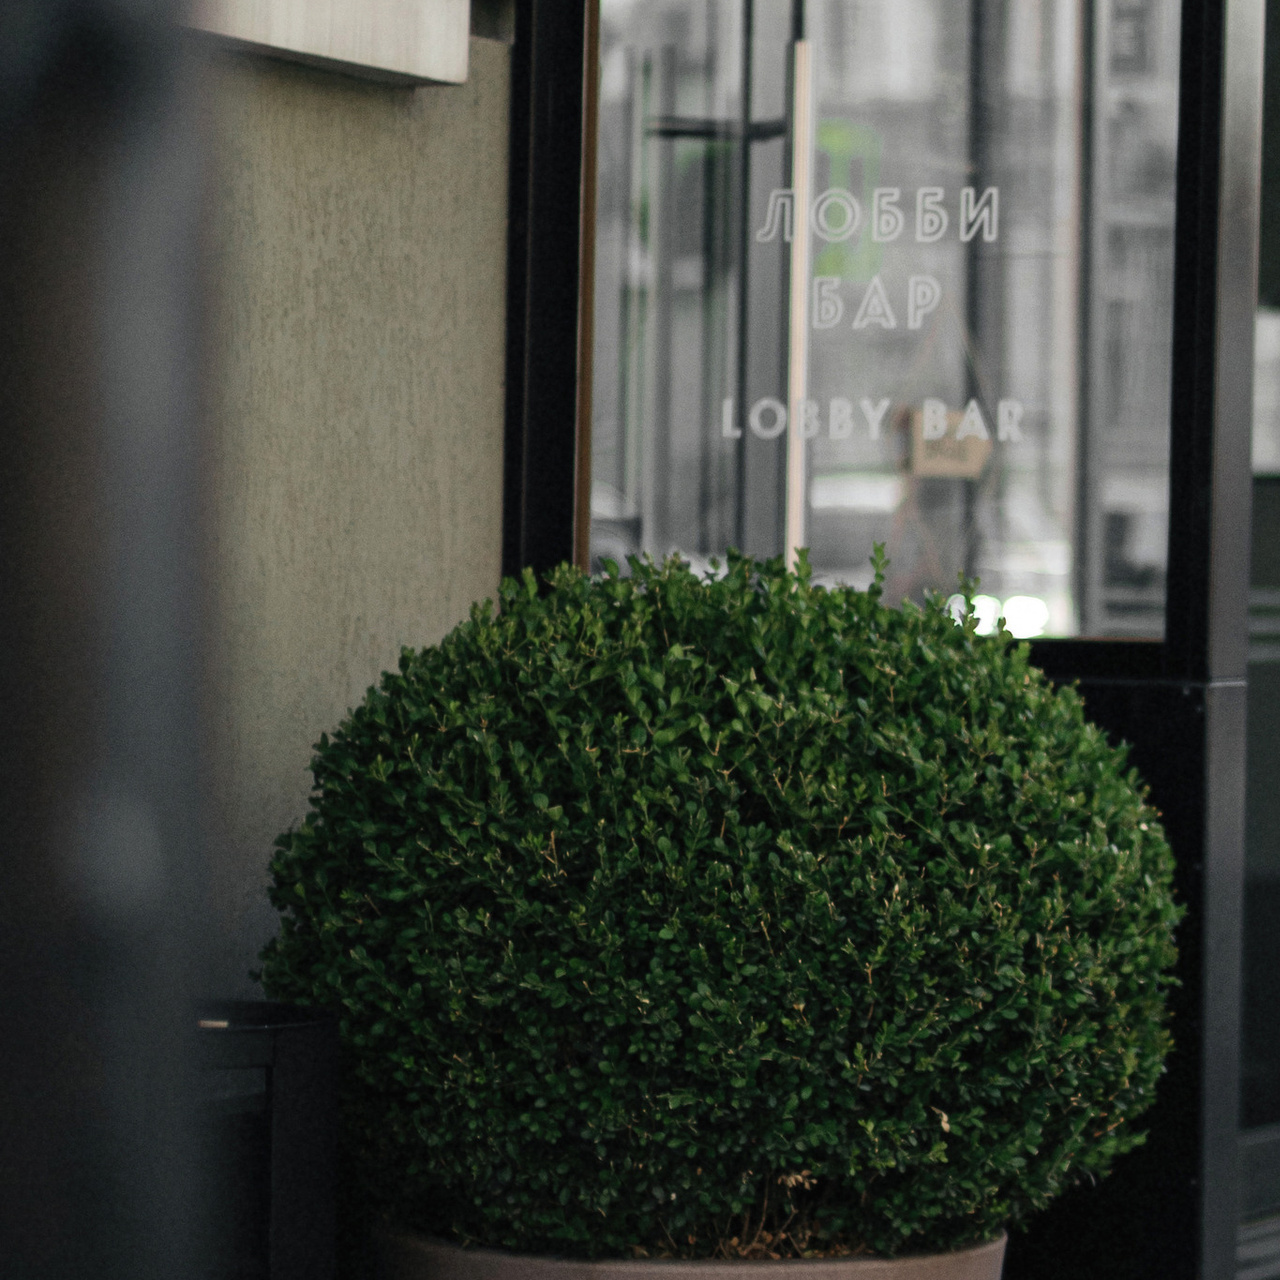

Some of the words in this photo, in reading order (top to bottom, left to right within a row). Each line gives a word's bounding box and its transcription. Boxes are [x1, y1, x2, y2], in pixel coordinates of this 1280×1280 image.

[756, 186, 999, 243] ЛОББИ
[812, 274, 942, 330] БАР
[722, 396, 891, 440] LOBBY
[922, 397, 1026, 442] BAR
